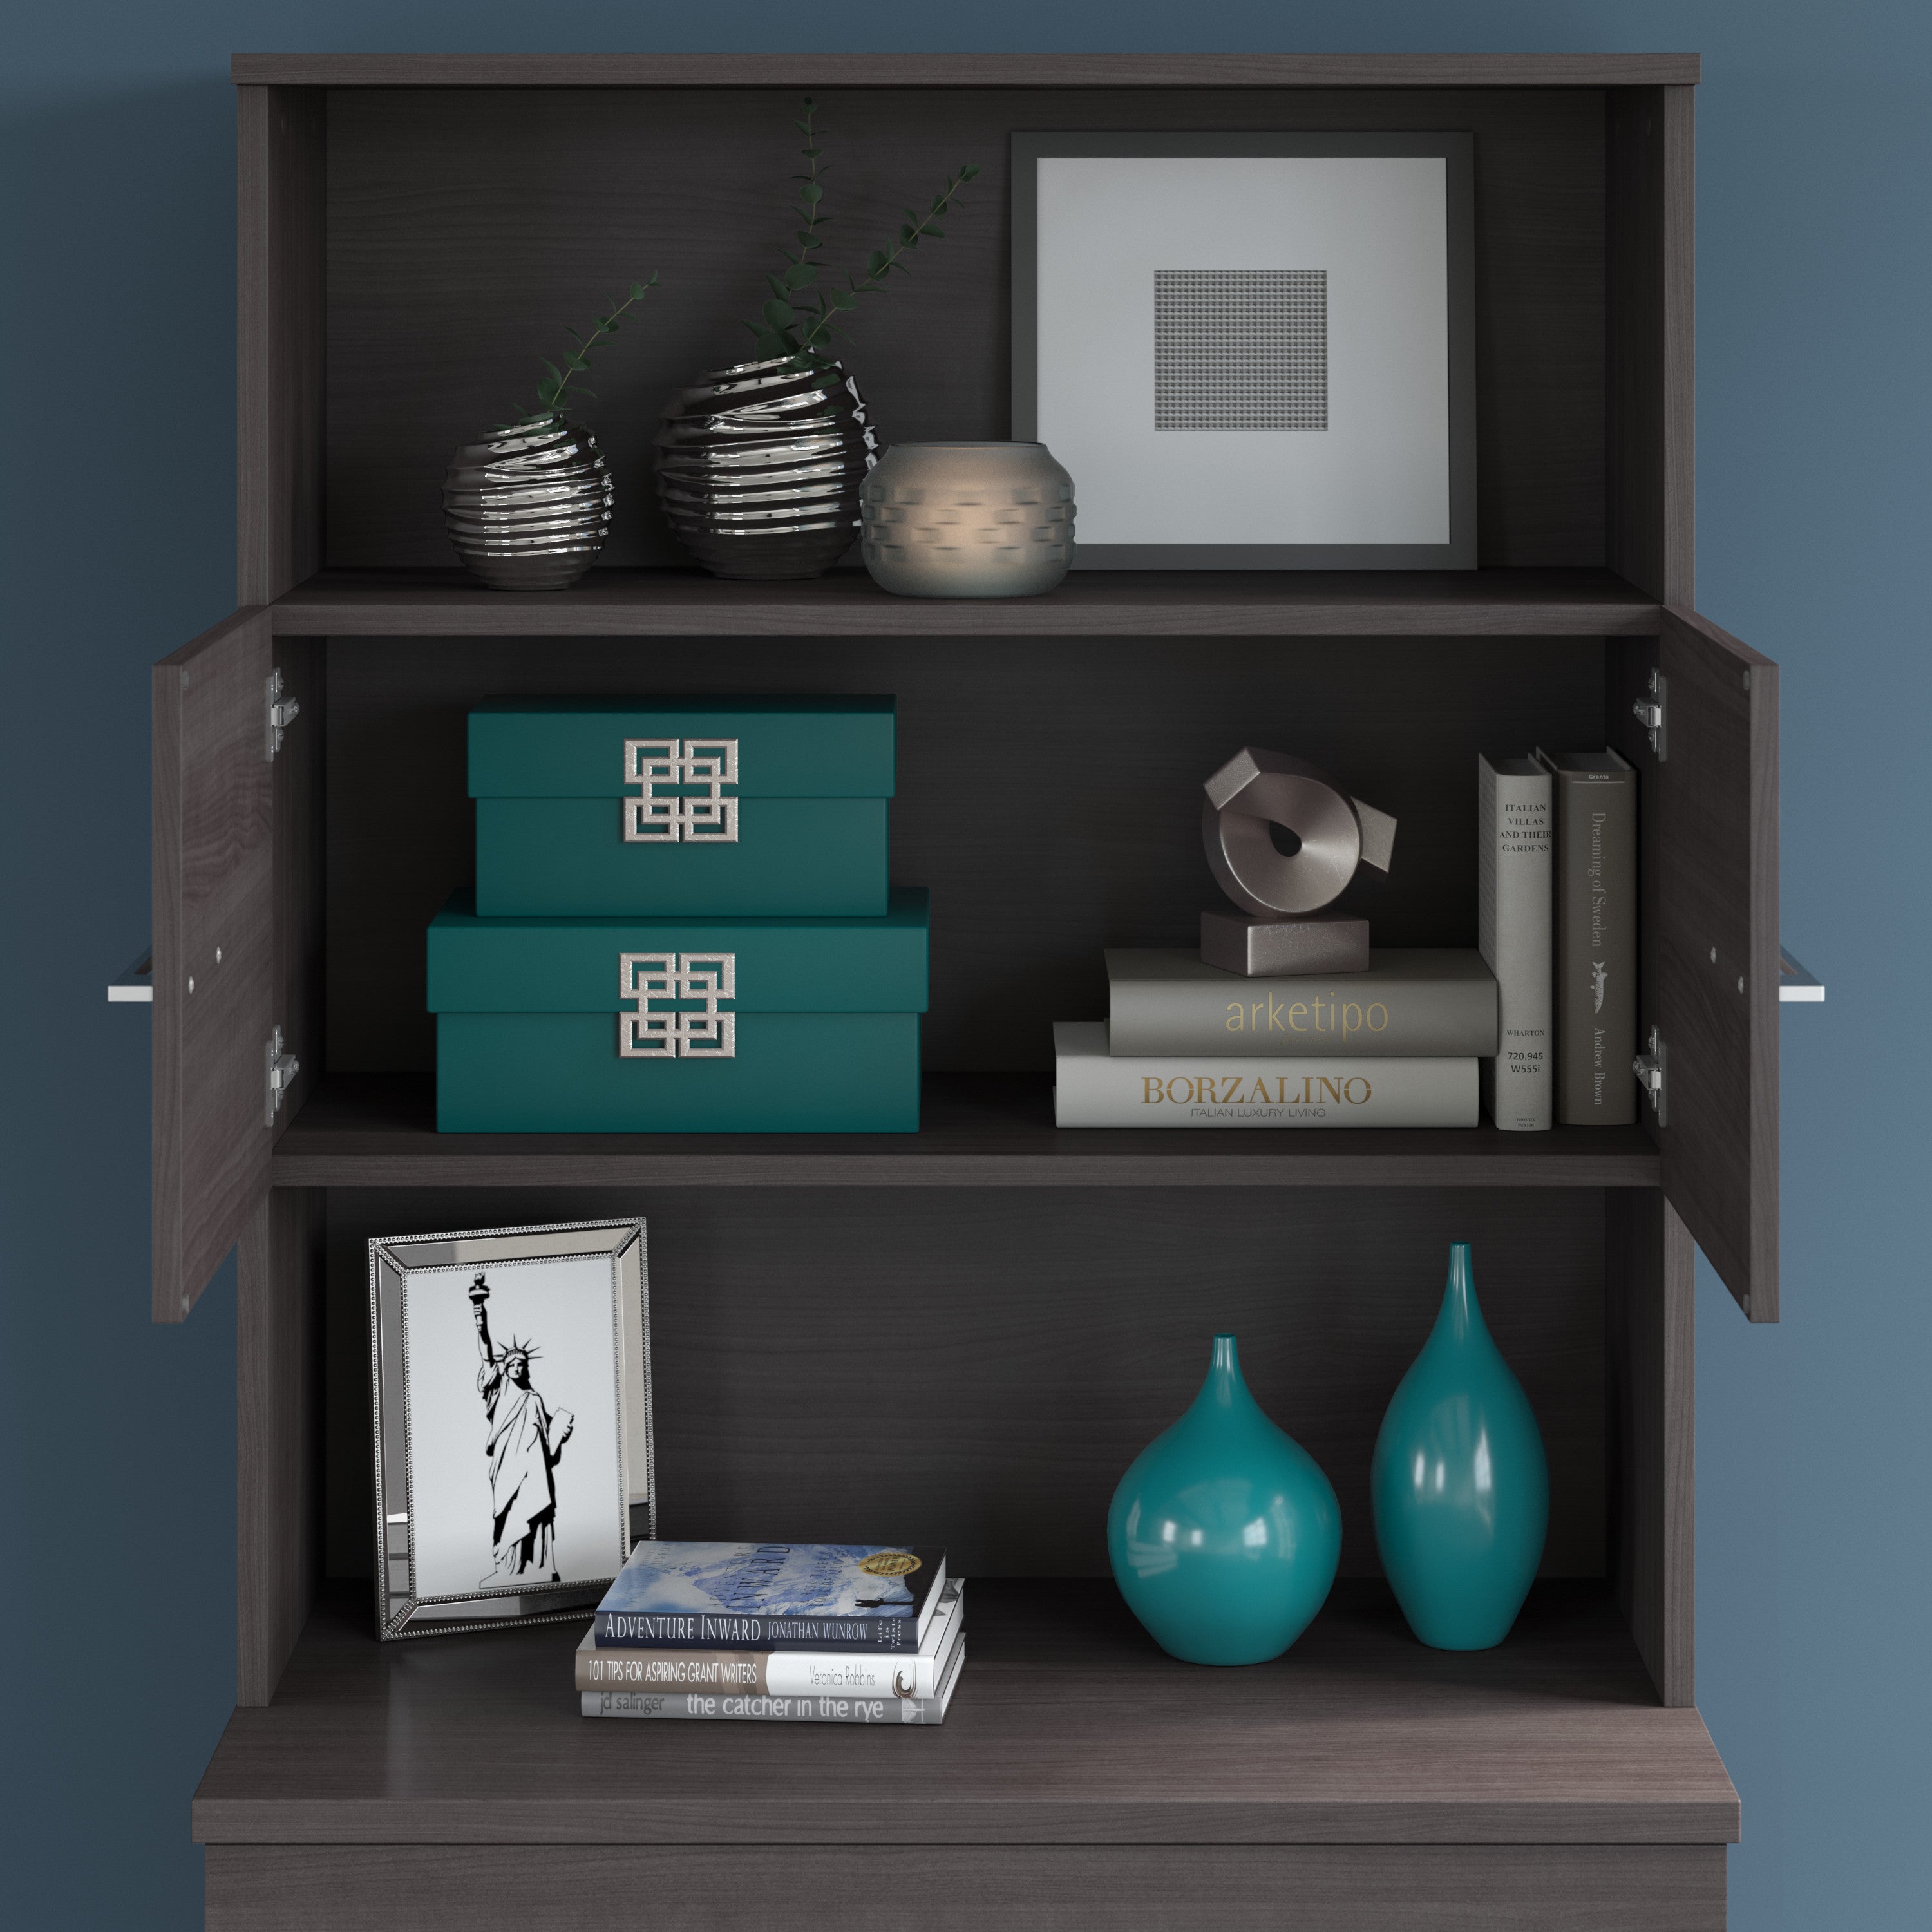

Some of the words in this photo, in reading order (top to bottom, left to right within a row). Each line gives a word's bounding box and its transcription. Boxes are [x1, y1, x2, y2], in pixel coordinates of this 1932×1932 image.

[1522, 830, 1551, 838] THEIR
[1588, 812, 1606, 876] Dreaming
[1592, 880, 1606, 894] of
[1592, 897, 1606, 947] Sweden
[1226, 990, 1388, 1044] arketipo
[1508, 1052, 1543, 1061] 720.945
[1594, 1028, 1606, 1068] Andrew
[1511, 1065, 1540, 1073] W555i
[1141, 1077, 1372, 1104] BORZALINO
[1594, 1072, 1605, 1104] Brown
[1191, 1108, 1233, 1117] ITALIAN
[1237, 1108, 1285, 1117] LUXURY
[1288, 1108, 1326, 1117] LIVING
[706, 1546, 754, 1607] ADVENTURE
[887, 1555, 899, 1571] WINNER
[726, 1546, 790, 1609] INWARD
[605, 1613, 694, 1639] ADVENTURE
[701, 1615, 761, 1640] INWARD
[768, 1622, 819, 1640] JONATHAN
[823, 1622, 867, 1640] WUNROW
[884, 1627, 889, 1638] is
[589, 1660, 603, 1680] 101
[607, 1660, 623, 1681] TIPS
[626, 1661, 643, 1681] FOR
[645, 1662, 685, 1682] ASPIRING
[688, 1662, 718, 1683] GRANT
[721, 1663, 757, 1683] WRITERS
[810, 1664, 842, 1685] Veronica
[846, 1664, 875, 1686] Robbins
[600, 1692, 611, 1714] jd
[616, 1692, 665, 1715] salinger
[687, 1694, 715, 1714] the
[722, 1694, 791, 1716] catcher
[797, 1696, 812, 1716] in
[819, 1696, 848, 1717] the
[855, 1700, 883, 1723] rye
